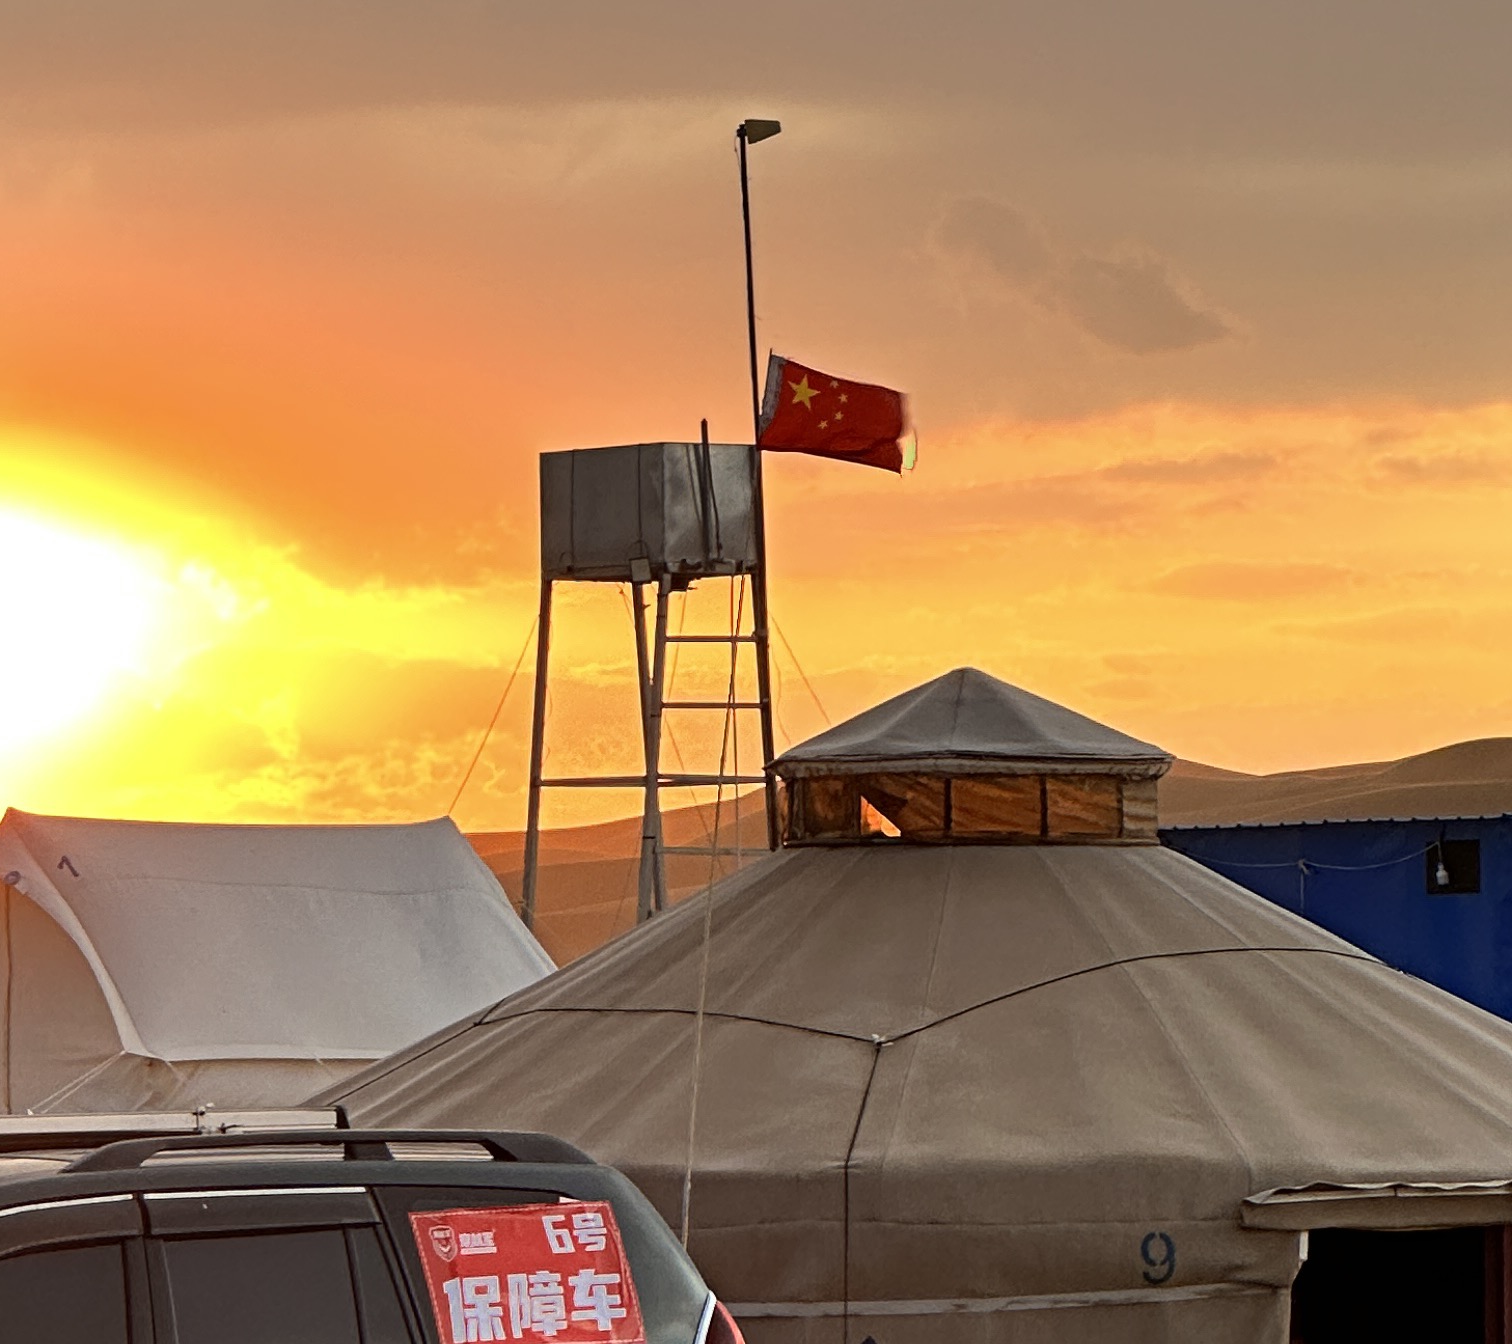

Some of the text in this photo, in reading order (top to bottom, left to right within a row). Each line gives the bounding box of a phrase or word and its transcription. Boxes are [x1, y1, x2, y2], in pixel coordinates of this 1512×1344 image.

[542, 1213, 607, 1253] 6号
[1141, 1232, 1176, 1285] 9
[443, 1269, 627, 1344] 保障车
